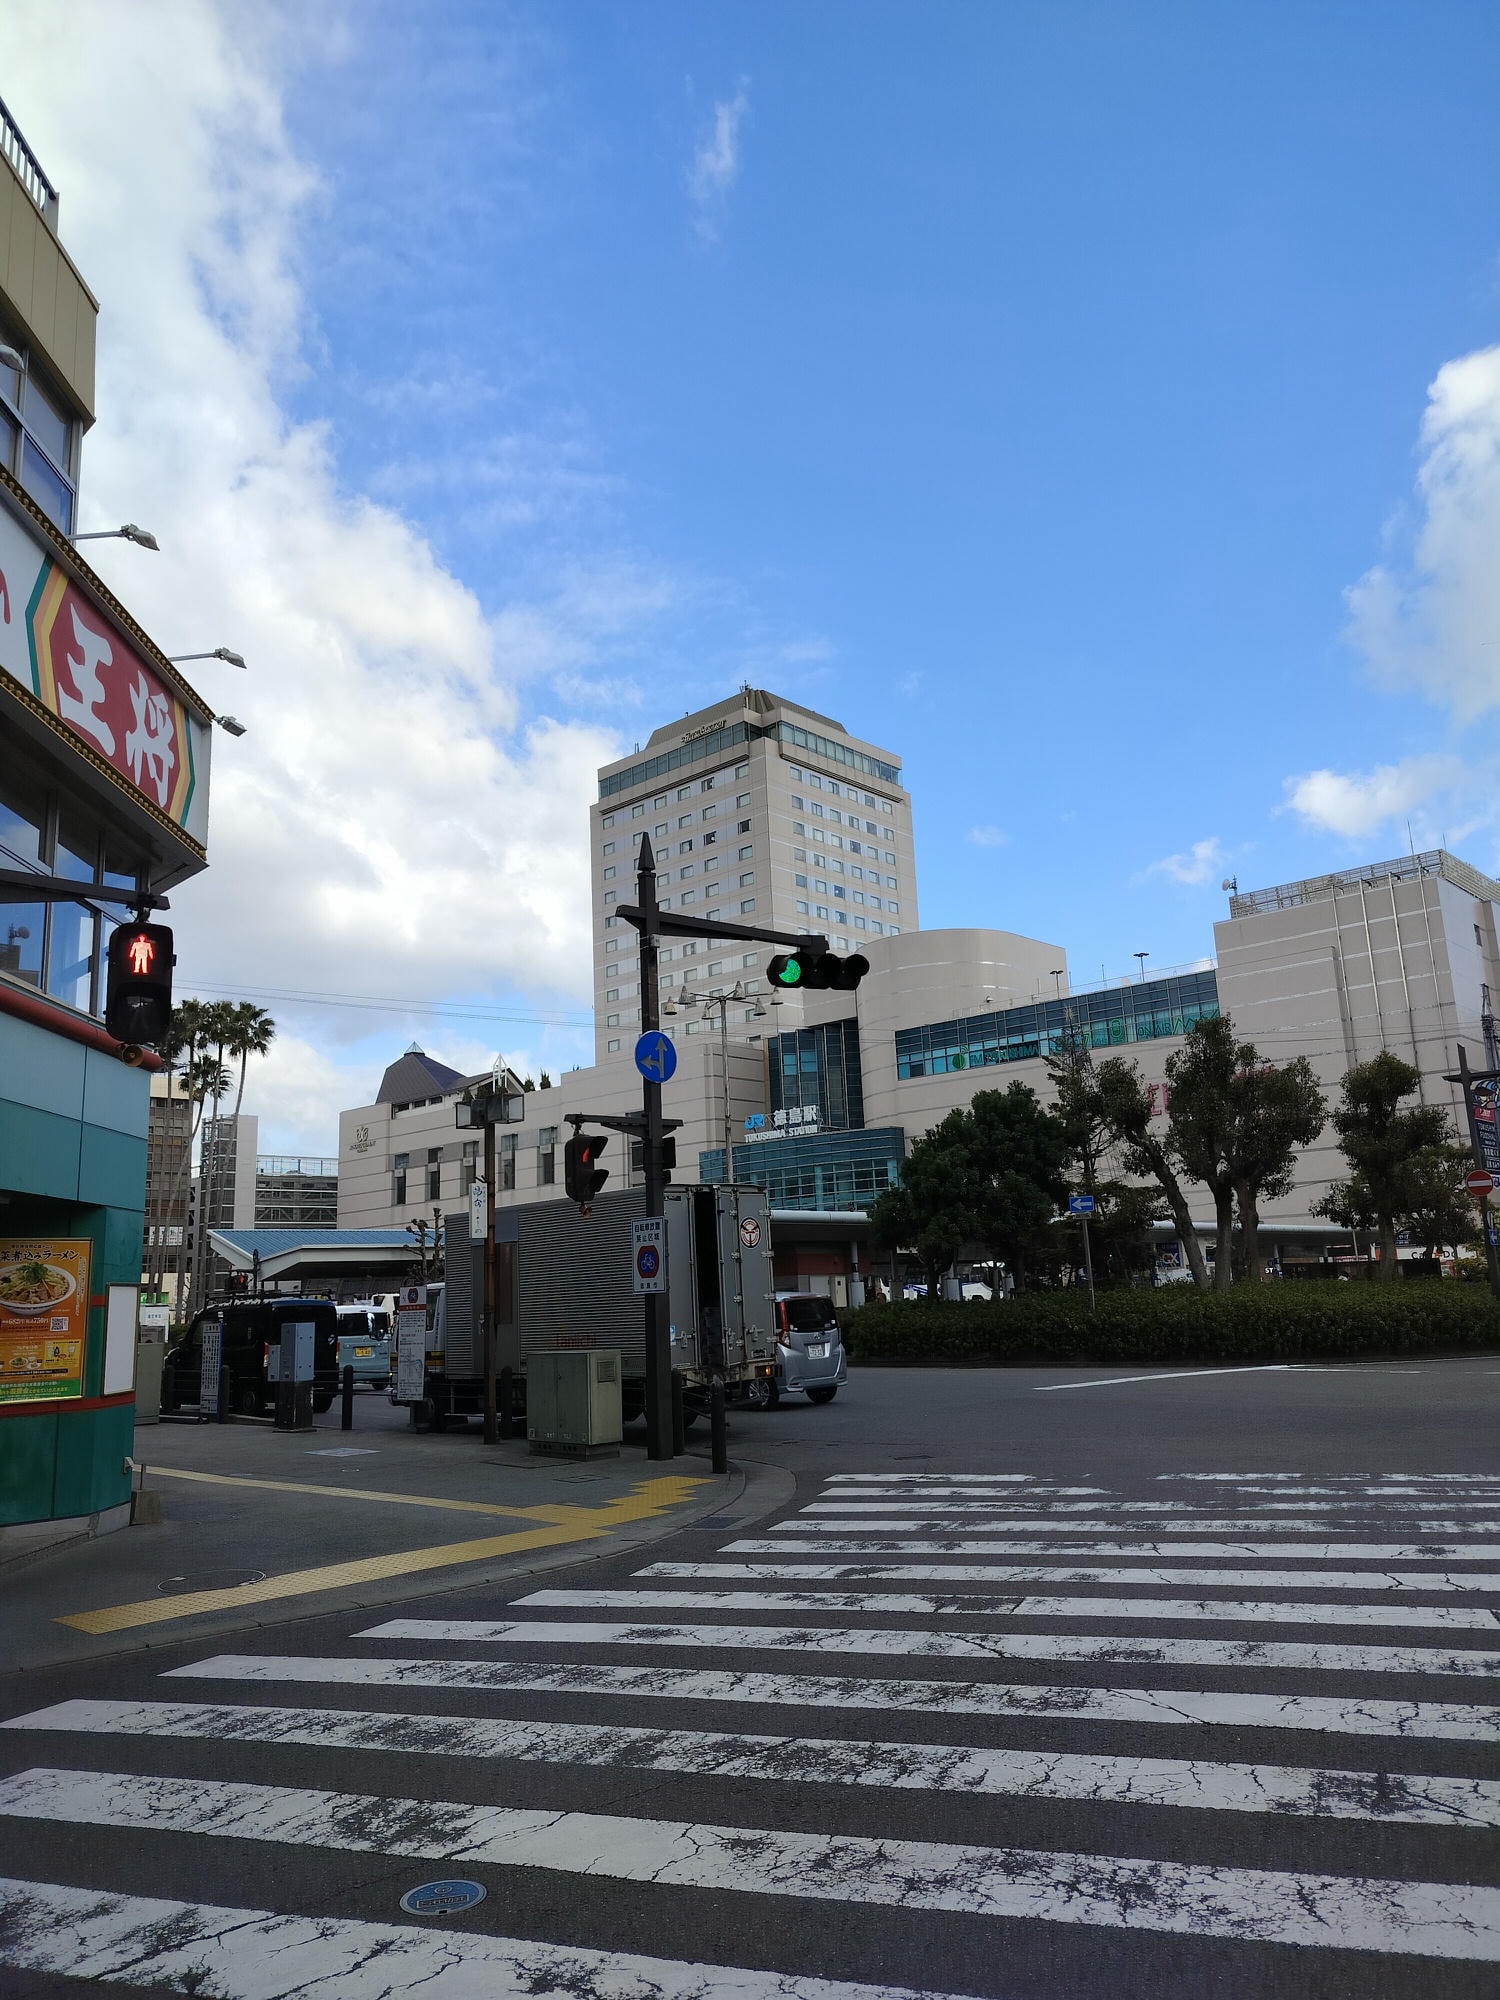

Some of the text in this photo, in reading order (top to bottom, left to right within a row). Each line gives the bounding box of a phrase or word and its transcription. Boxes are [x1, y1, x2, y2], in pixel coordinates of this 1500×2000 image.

[58, 602, 175, 809] 王将
[744, 1104, 817, 1130] JR 徳島駅
[744, 1124, 818, 1143] TOKUSHIMA STATION
